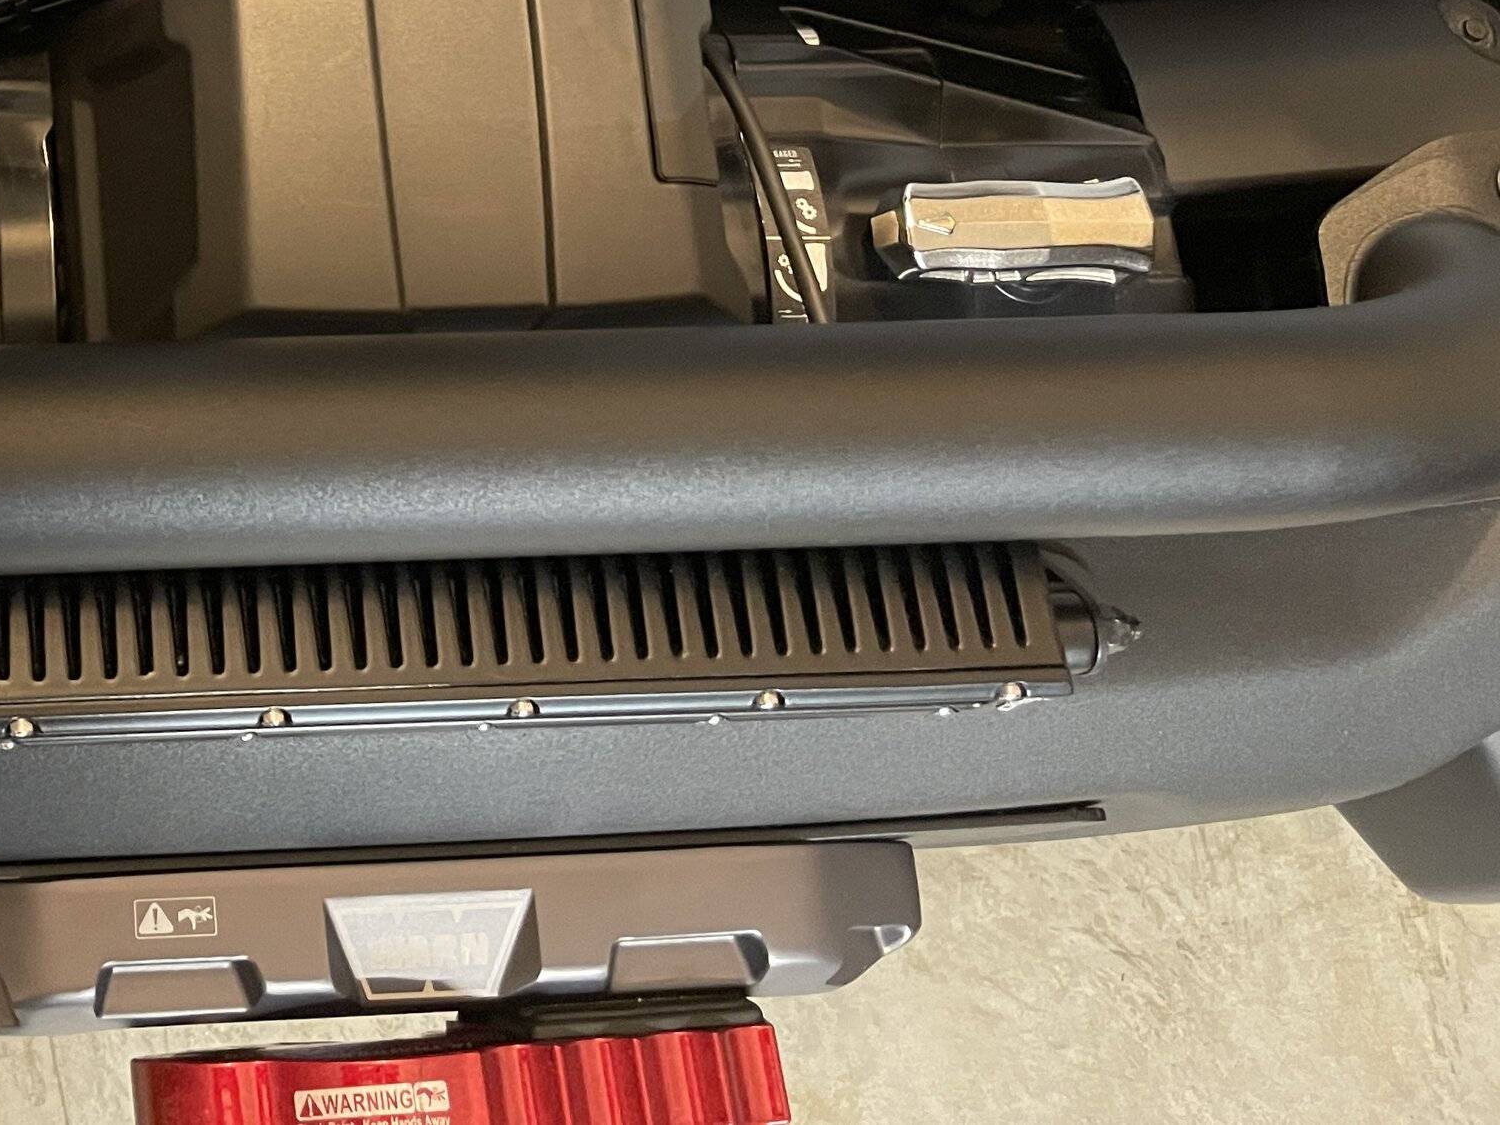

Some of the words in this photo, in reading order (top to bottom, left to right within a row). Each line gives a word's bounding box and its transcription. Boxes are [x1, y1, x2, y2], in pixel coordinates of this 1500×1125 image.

[321, 1089, 413, 1114] WARNING
[390, 1115, 422, 1125] Hands
[424, 1113, 451, 1125] Away
